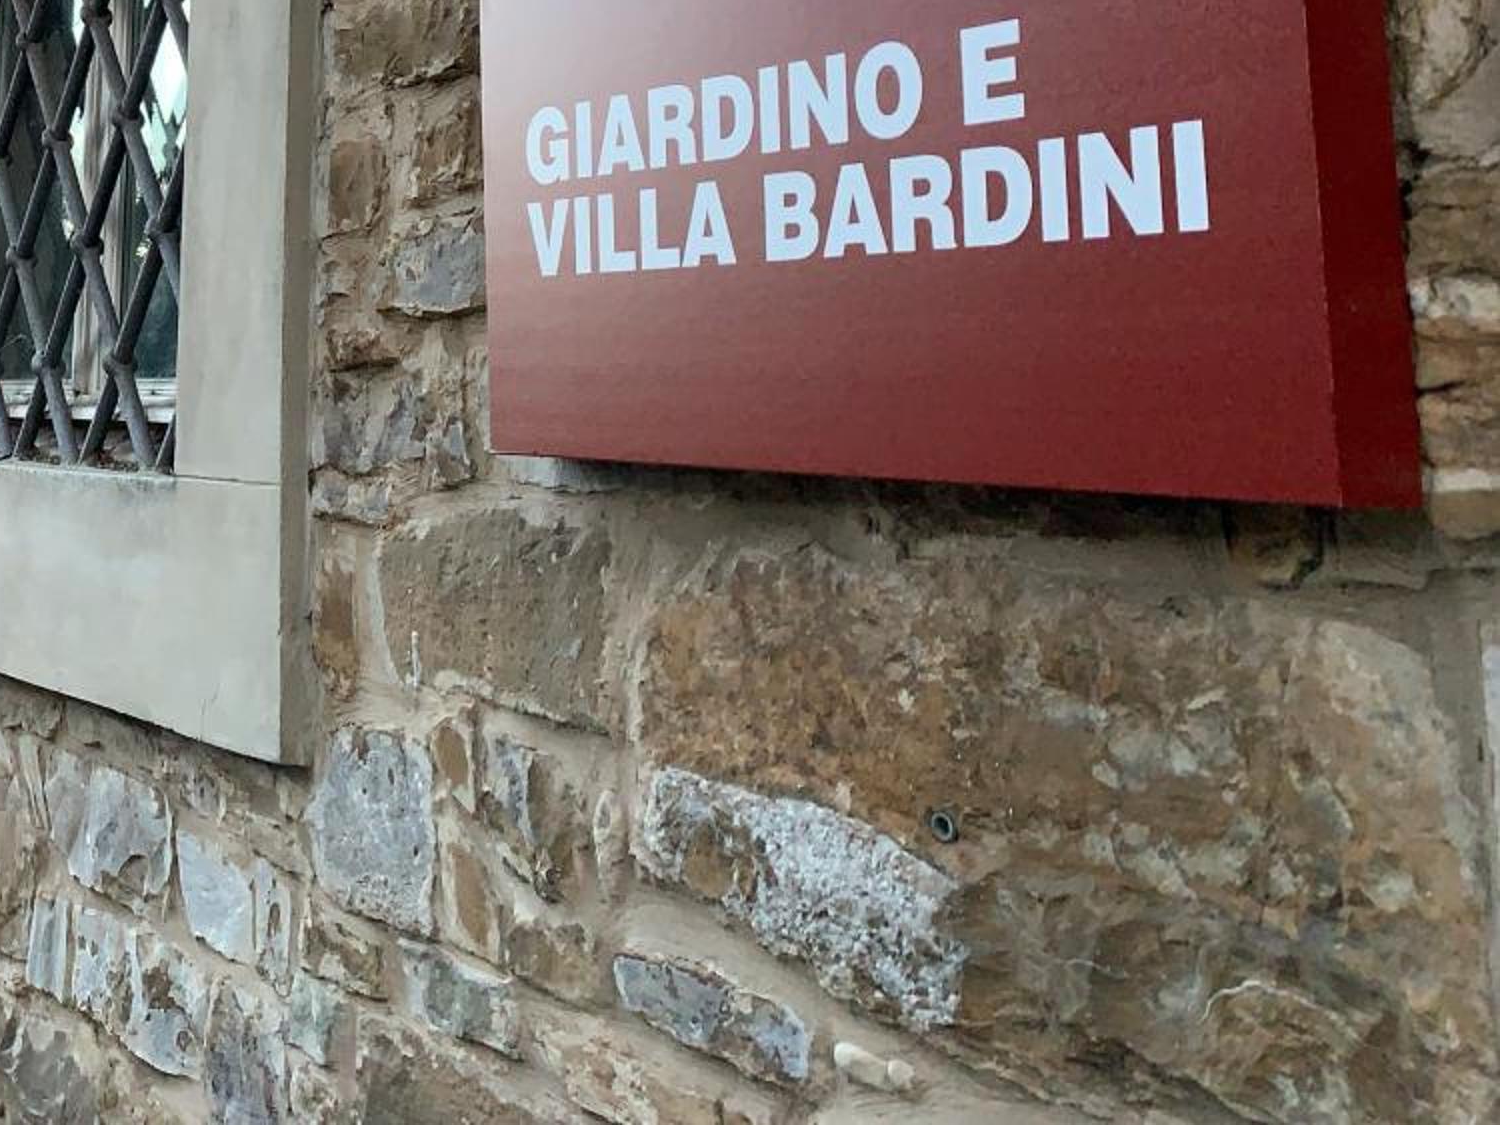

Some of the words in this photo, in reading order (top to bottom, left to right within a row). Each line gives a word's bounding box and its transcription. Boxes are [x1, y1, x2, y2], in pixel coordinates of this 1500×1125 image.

[525, 41, 924, 185] GIARDINO
[959, 18, 1026, 126] E
[527, 181, 737, 277] VILLA
[763, 119, 1210, 263] BARDINI
